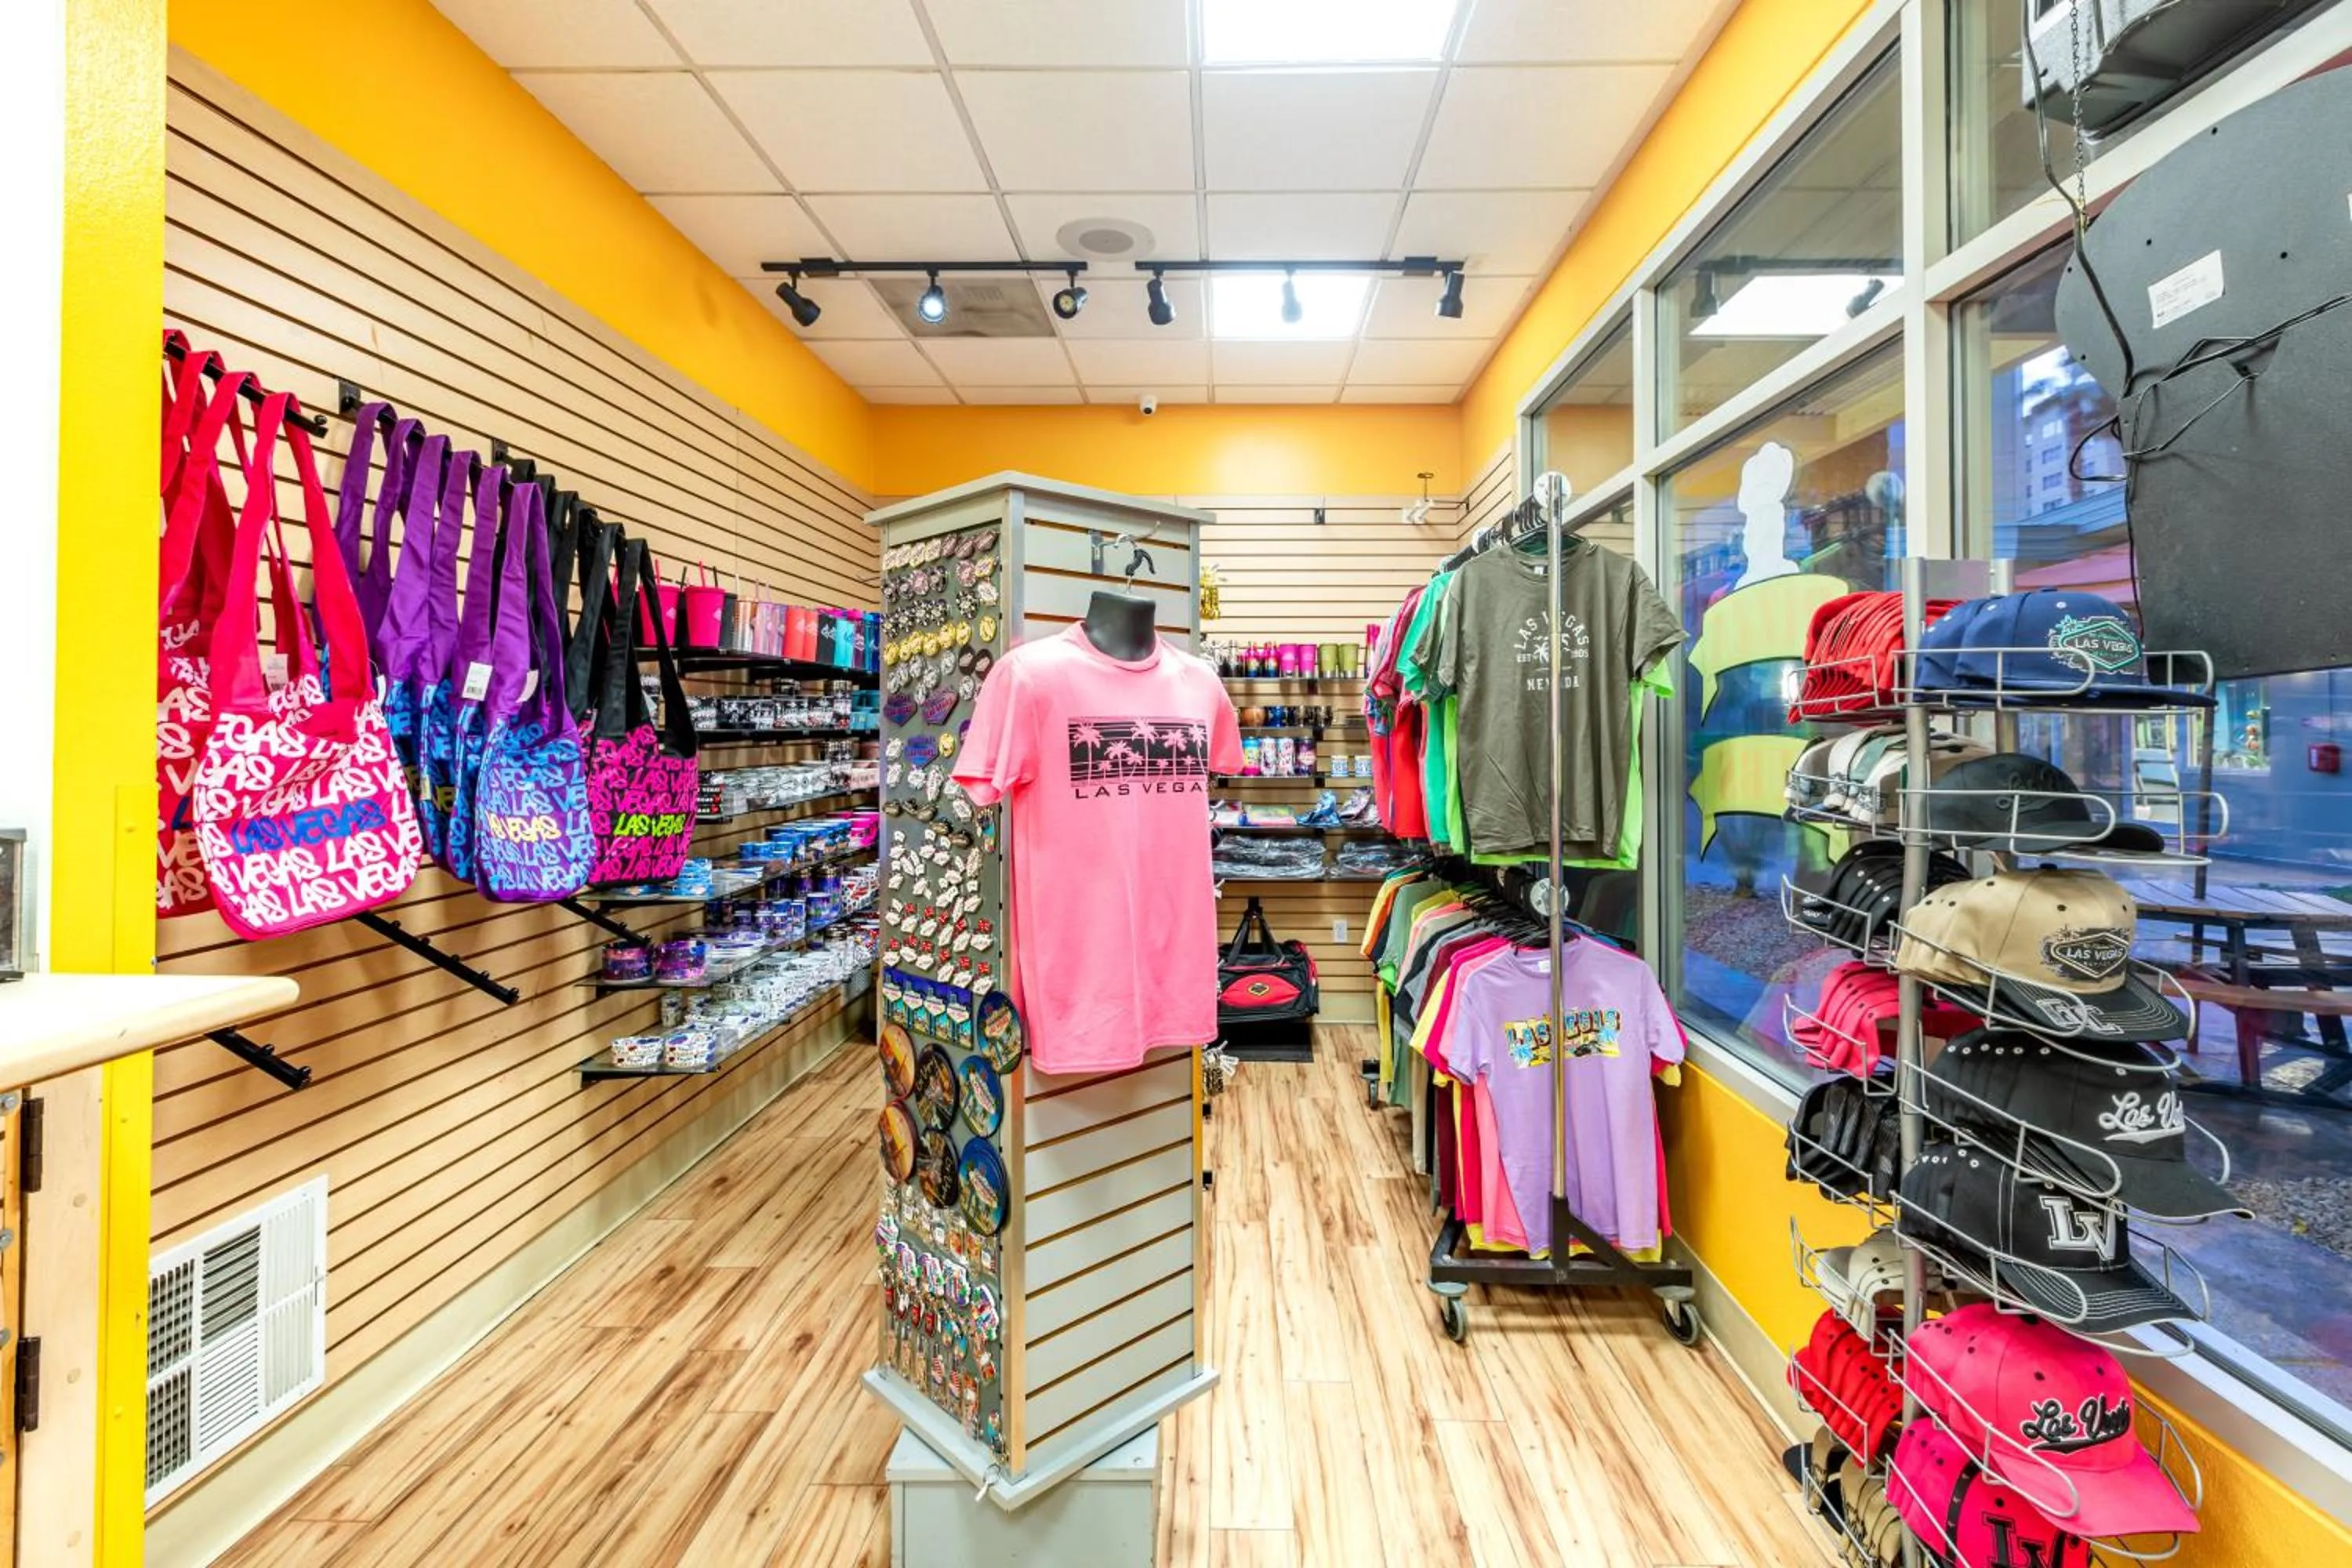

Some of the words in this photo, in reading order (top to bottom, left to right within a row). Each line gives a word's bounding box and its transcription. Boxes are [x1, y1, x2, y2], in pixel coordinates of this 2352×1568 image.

[1513, 618, 1537, 650] LAS
[1542, 612, 1590, 647] VGAS
[2074, 638, 2100, 649] LAS
[1526, 676, 1580, 691] NEDA
[311, 767, 379, 807] LAS
[510, 789, 554, 816] LAS
[1075, 783, 1130, 799] LAS
[230, 815, 284, 854] LAS
[279, 798, 387, 848] VEGAS
[613, 812, 651, 837] LAS
[228, 847, 323, 894] VEGAS
[326, 830, 387, 874] LAS
[287, 877, 347, 917] LAS
[2066, 946, 2092, 958] LAS
[1506, 1022, 1552, 1051] LAS
[1564, 1009, 1622, 1040] EGAS
[2099, 1091, 2156, 1131] Las
[2038, 1194, 2116, 1261] LV
[2020, 1398, 2079, 1443] Las
